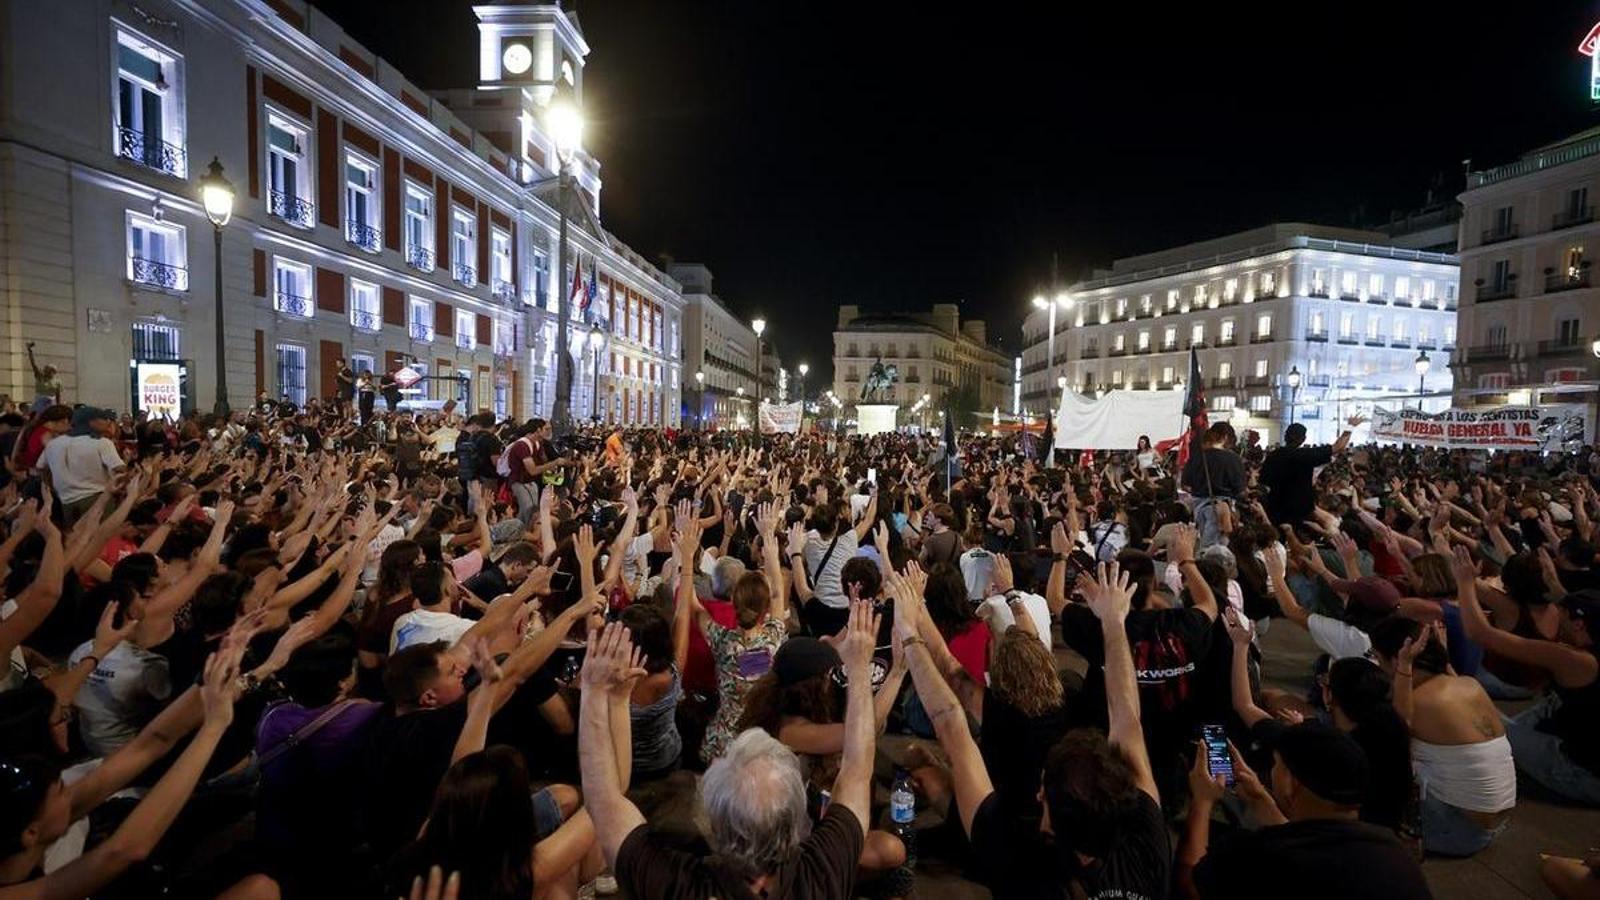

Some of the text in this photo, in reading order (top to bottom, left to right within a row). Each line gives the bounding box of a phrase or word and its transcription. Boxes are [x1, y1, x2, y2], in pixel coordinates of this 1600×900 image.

[144, 385, 176, 393] BURGER
[144, 394, 176, 404] KING
[1403, 420, 1444, 435] HUELGA
[1447, 423, 1506, 437] GENERAL
[1513, 421, 1532, 437] YA
